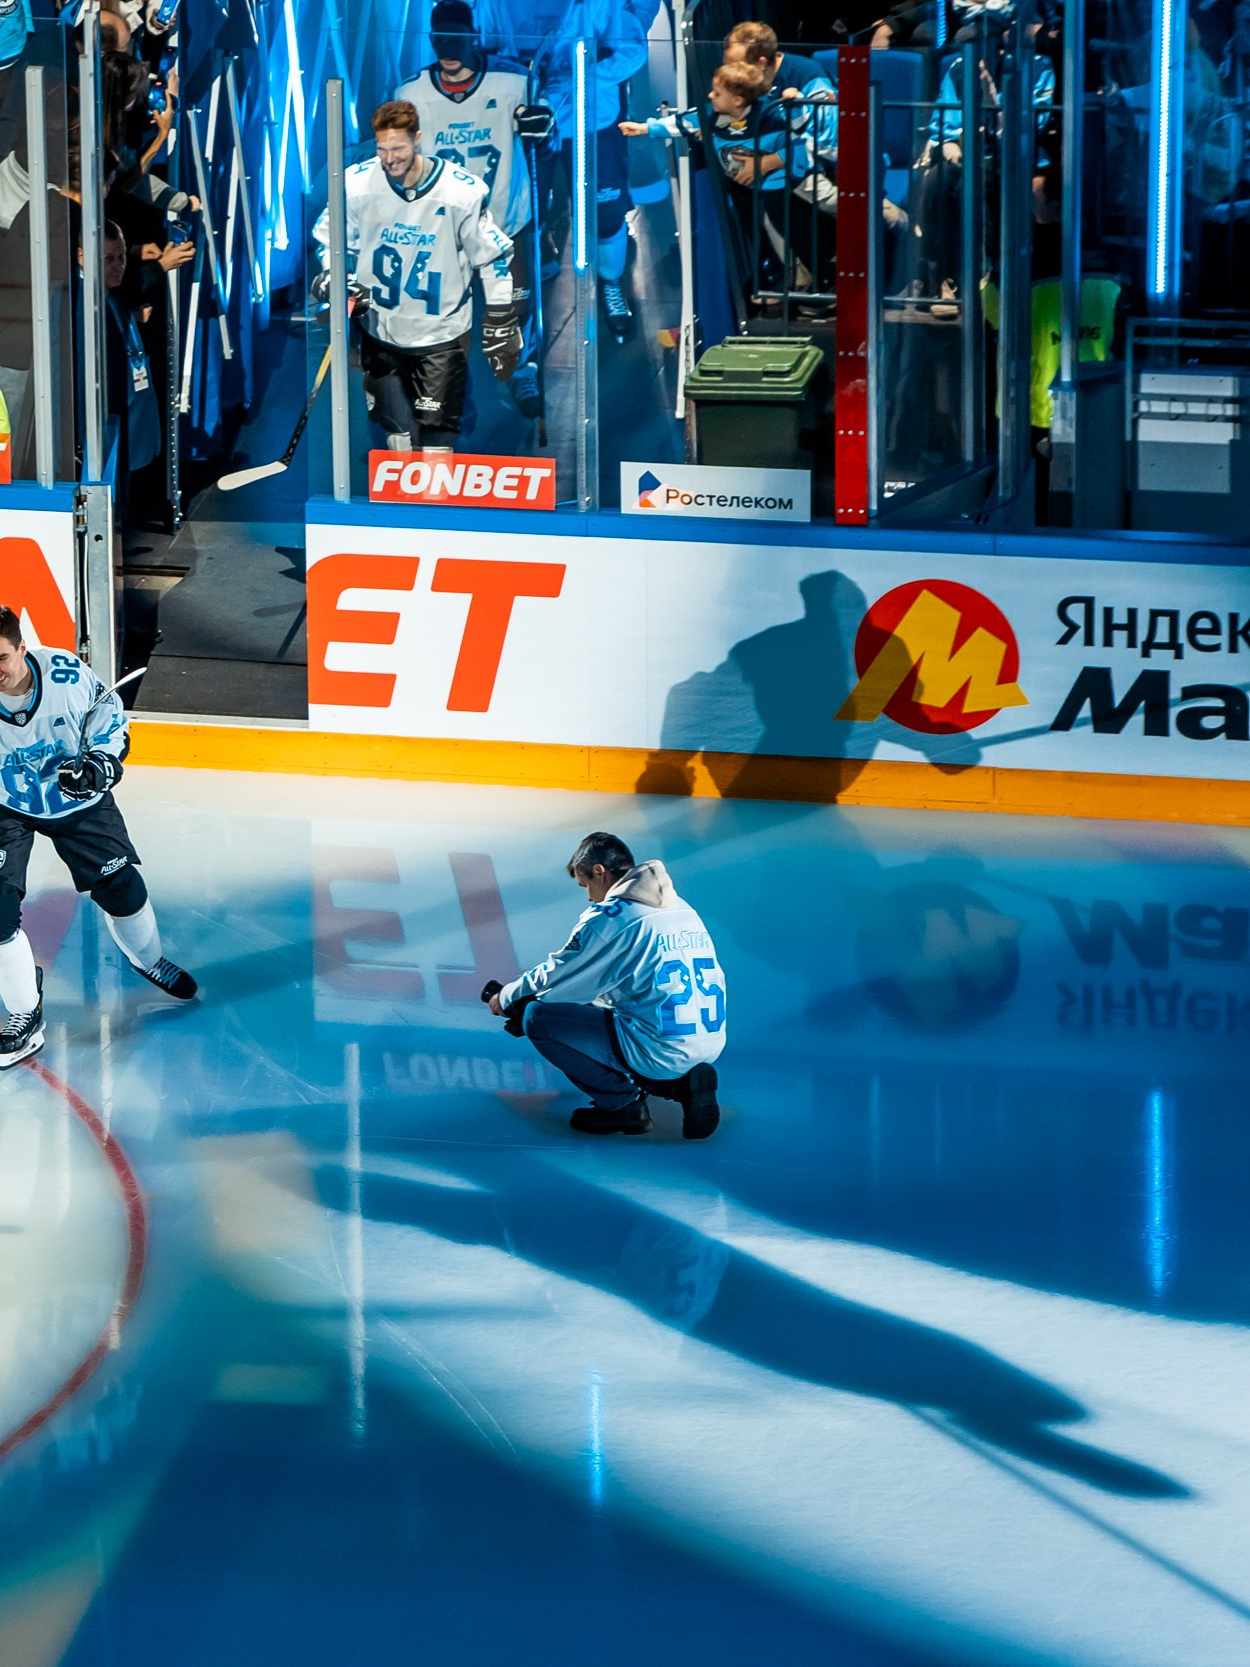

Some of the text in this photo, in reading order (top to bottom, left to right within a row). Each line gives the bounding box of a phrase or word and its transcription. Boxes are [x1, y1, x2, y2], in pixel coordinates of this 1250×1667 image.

[371, 243, 443, 316] 94
[371, 460, 552, 501] FONBET
[665, 487, 794, 512] Ростелеком
[655, 957, 727, 1037] 25
